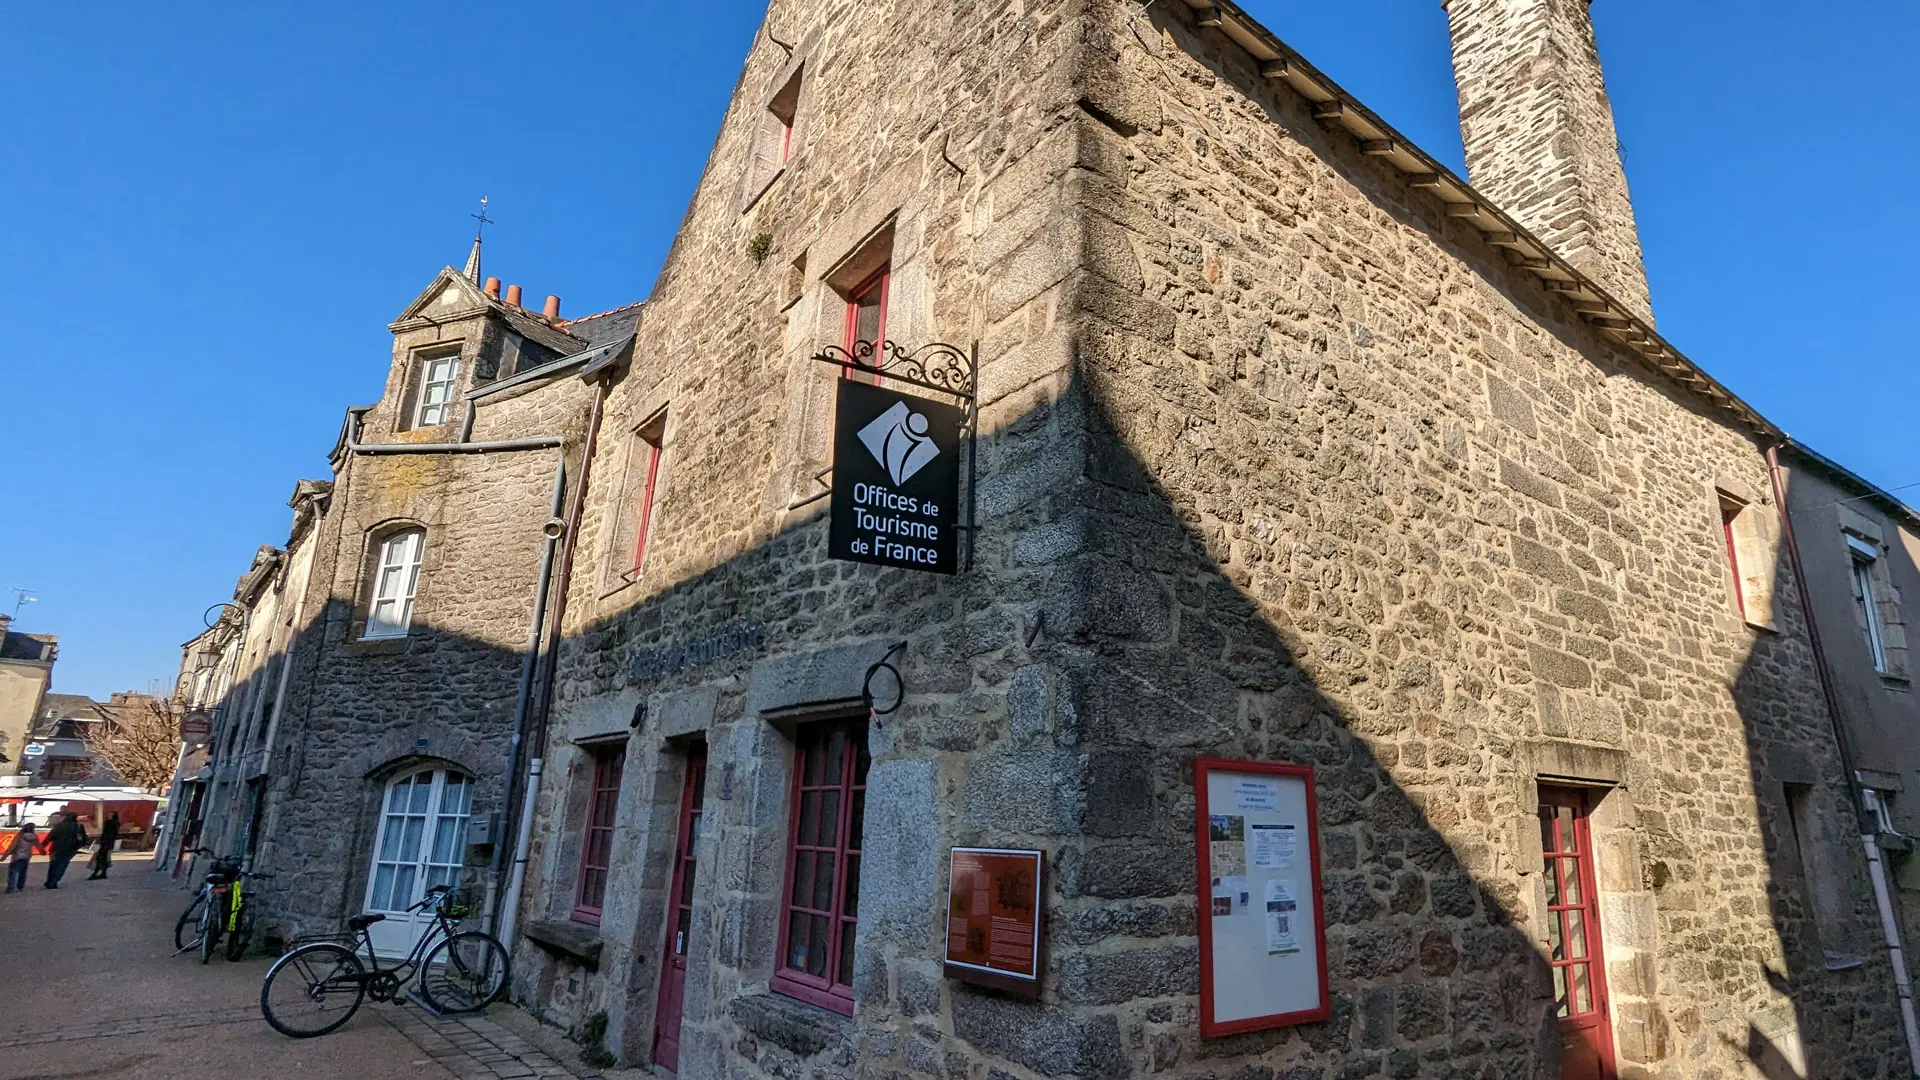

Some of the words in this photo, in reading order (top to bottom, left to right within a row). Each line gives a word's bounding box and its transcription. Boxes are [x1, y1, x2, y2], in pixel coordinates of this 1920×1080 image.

[853, 482, 918, 513] Offices
[923, 500, 939, 517] de
[852, 506, 938, 541] Tourisme
[850, 537, 869, 555] de
[874, 535, 938, 565] France
